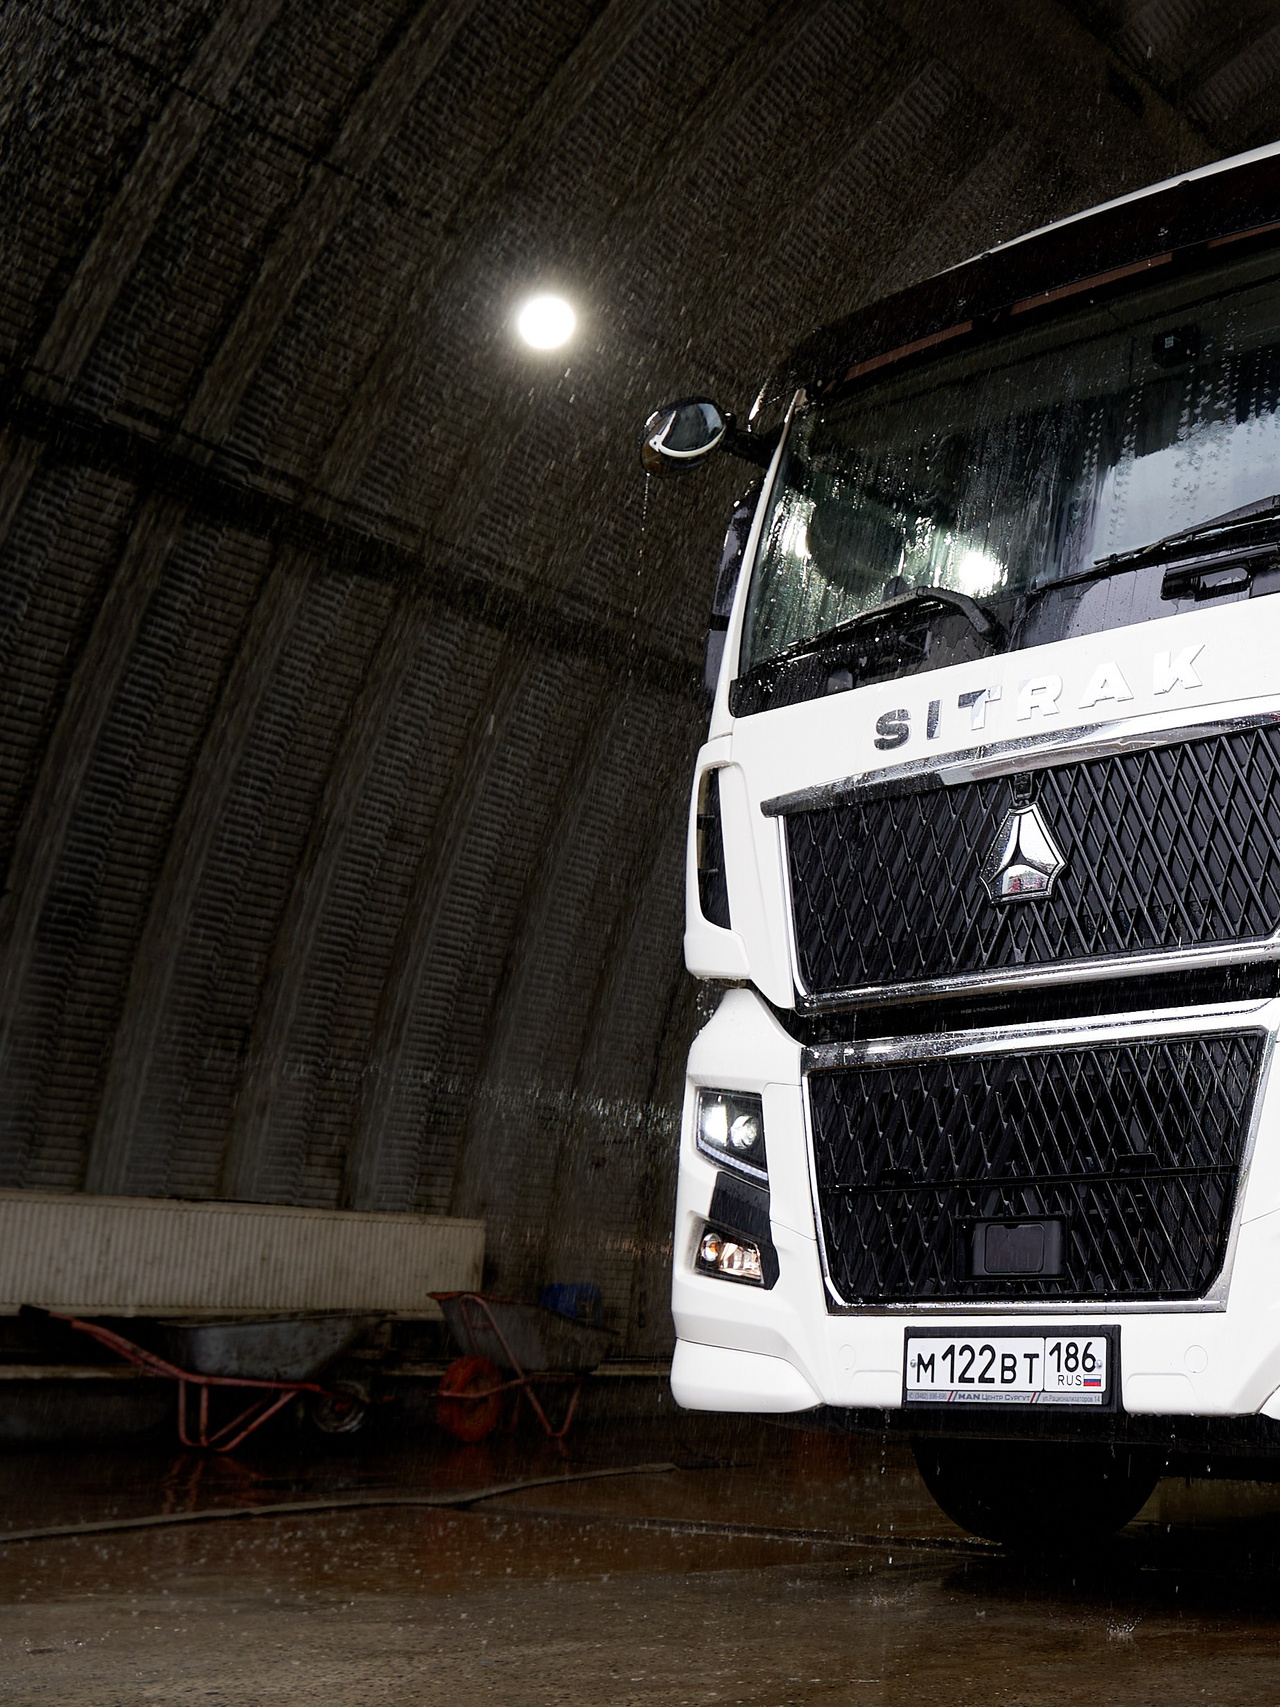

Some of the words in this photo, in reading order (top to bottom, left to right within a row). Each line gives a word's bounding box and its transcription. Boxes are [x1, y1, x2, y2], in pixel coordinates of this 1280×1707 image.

[874, 644, 1205, 751] SITRAK
[1049, 1341, 1097, 1373] 186
[1058, 1374, 1082, 1386] RUS
[958, 1393, 981, 1401] MAN
